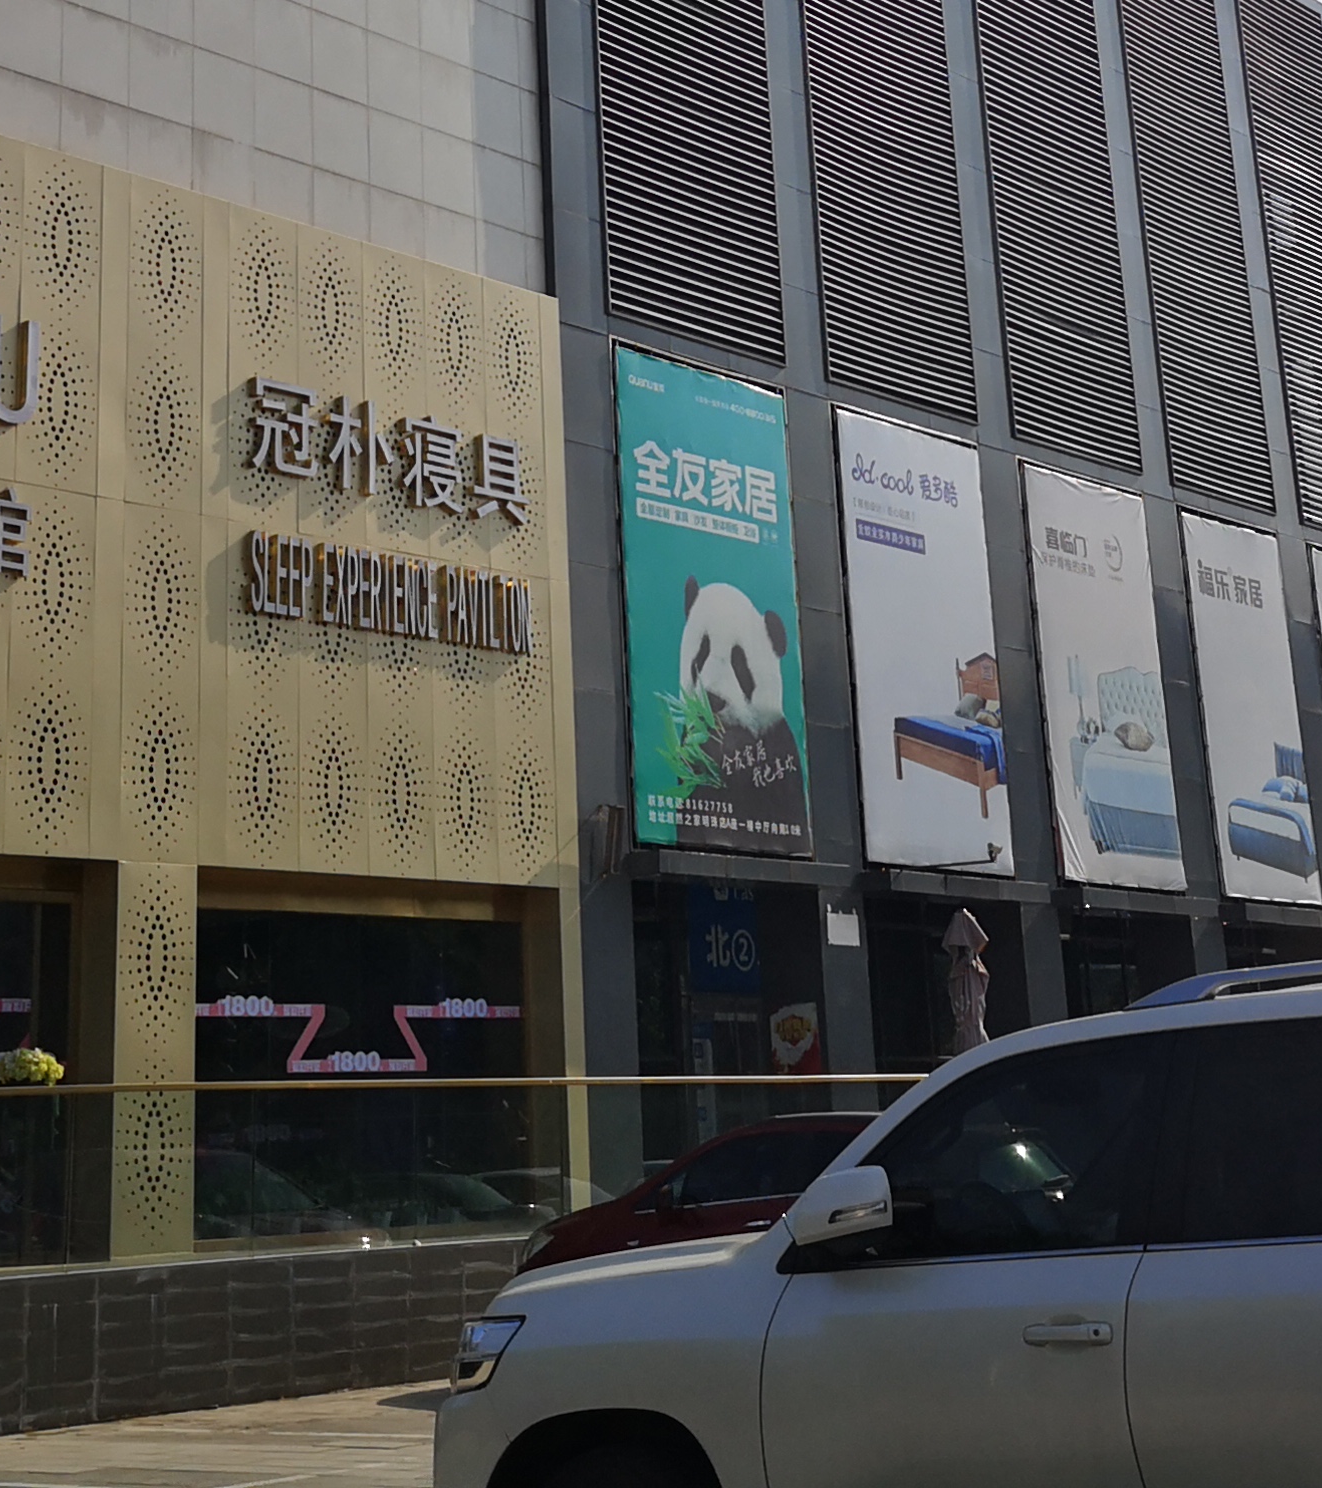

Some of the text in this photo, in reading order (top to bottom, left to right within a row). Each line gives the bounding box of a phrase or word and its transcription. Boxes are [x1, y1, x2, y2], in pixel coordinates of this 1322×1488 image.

[248, 376, 531, 526] 冠朴寝具
[633, 440, 778, 523] 全友家居
[1045, 526, 1087, 558] 喜临门
[251, 530, 314, 617] SLEEP
[322, 542, 439, 640] EXPERIENCE
[1197, 559, 1263, 609] 福乐家居
[221, 995, 274, 1016] 1800
[443, 998, 489, 1018] 1800
[330, 1051, 380, 1072] 1800
